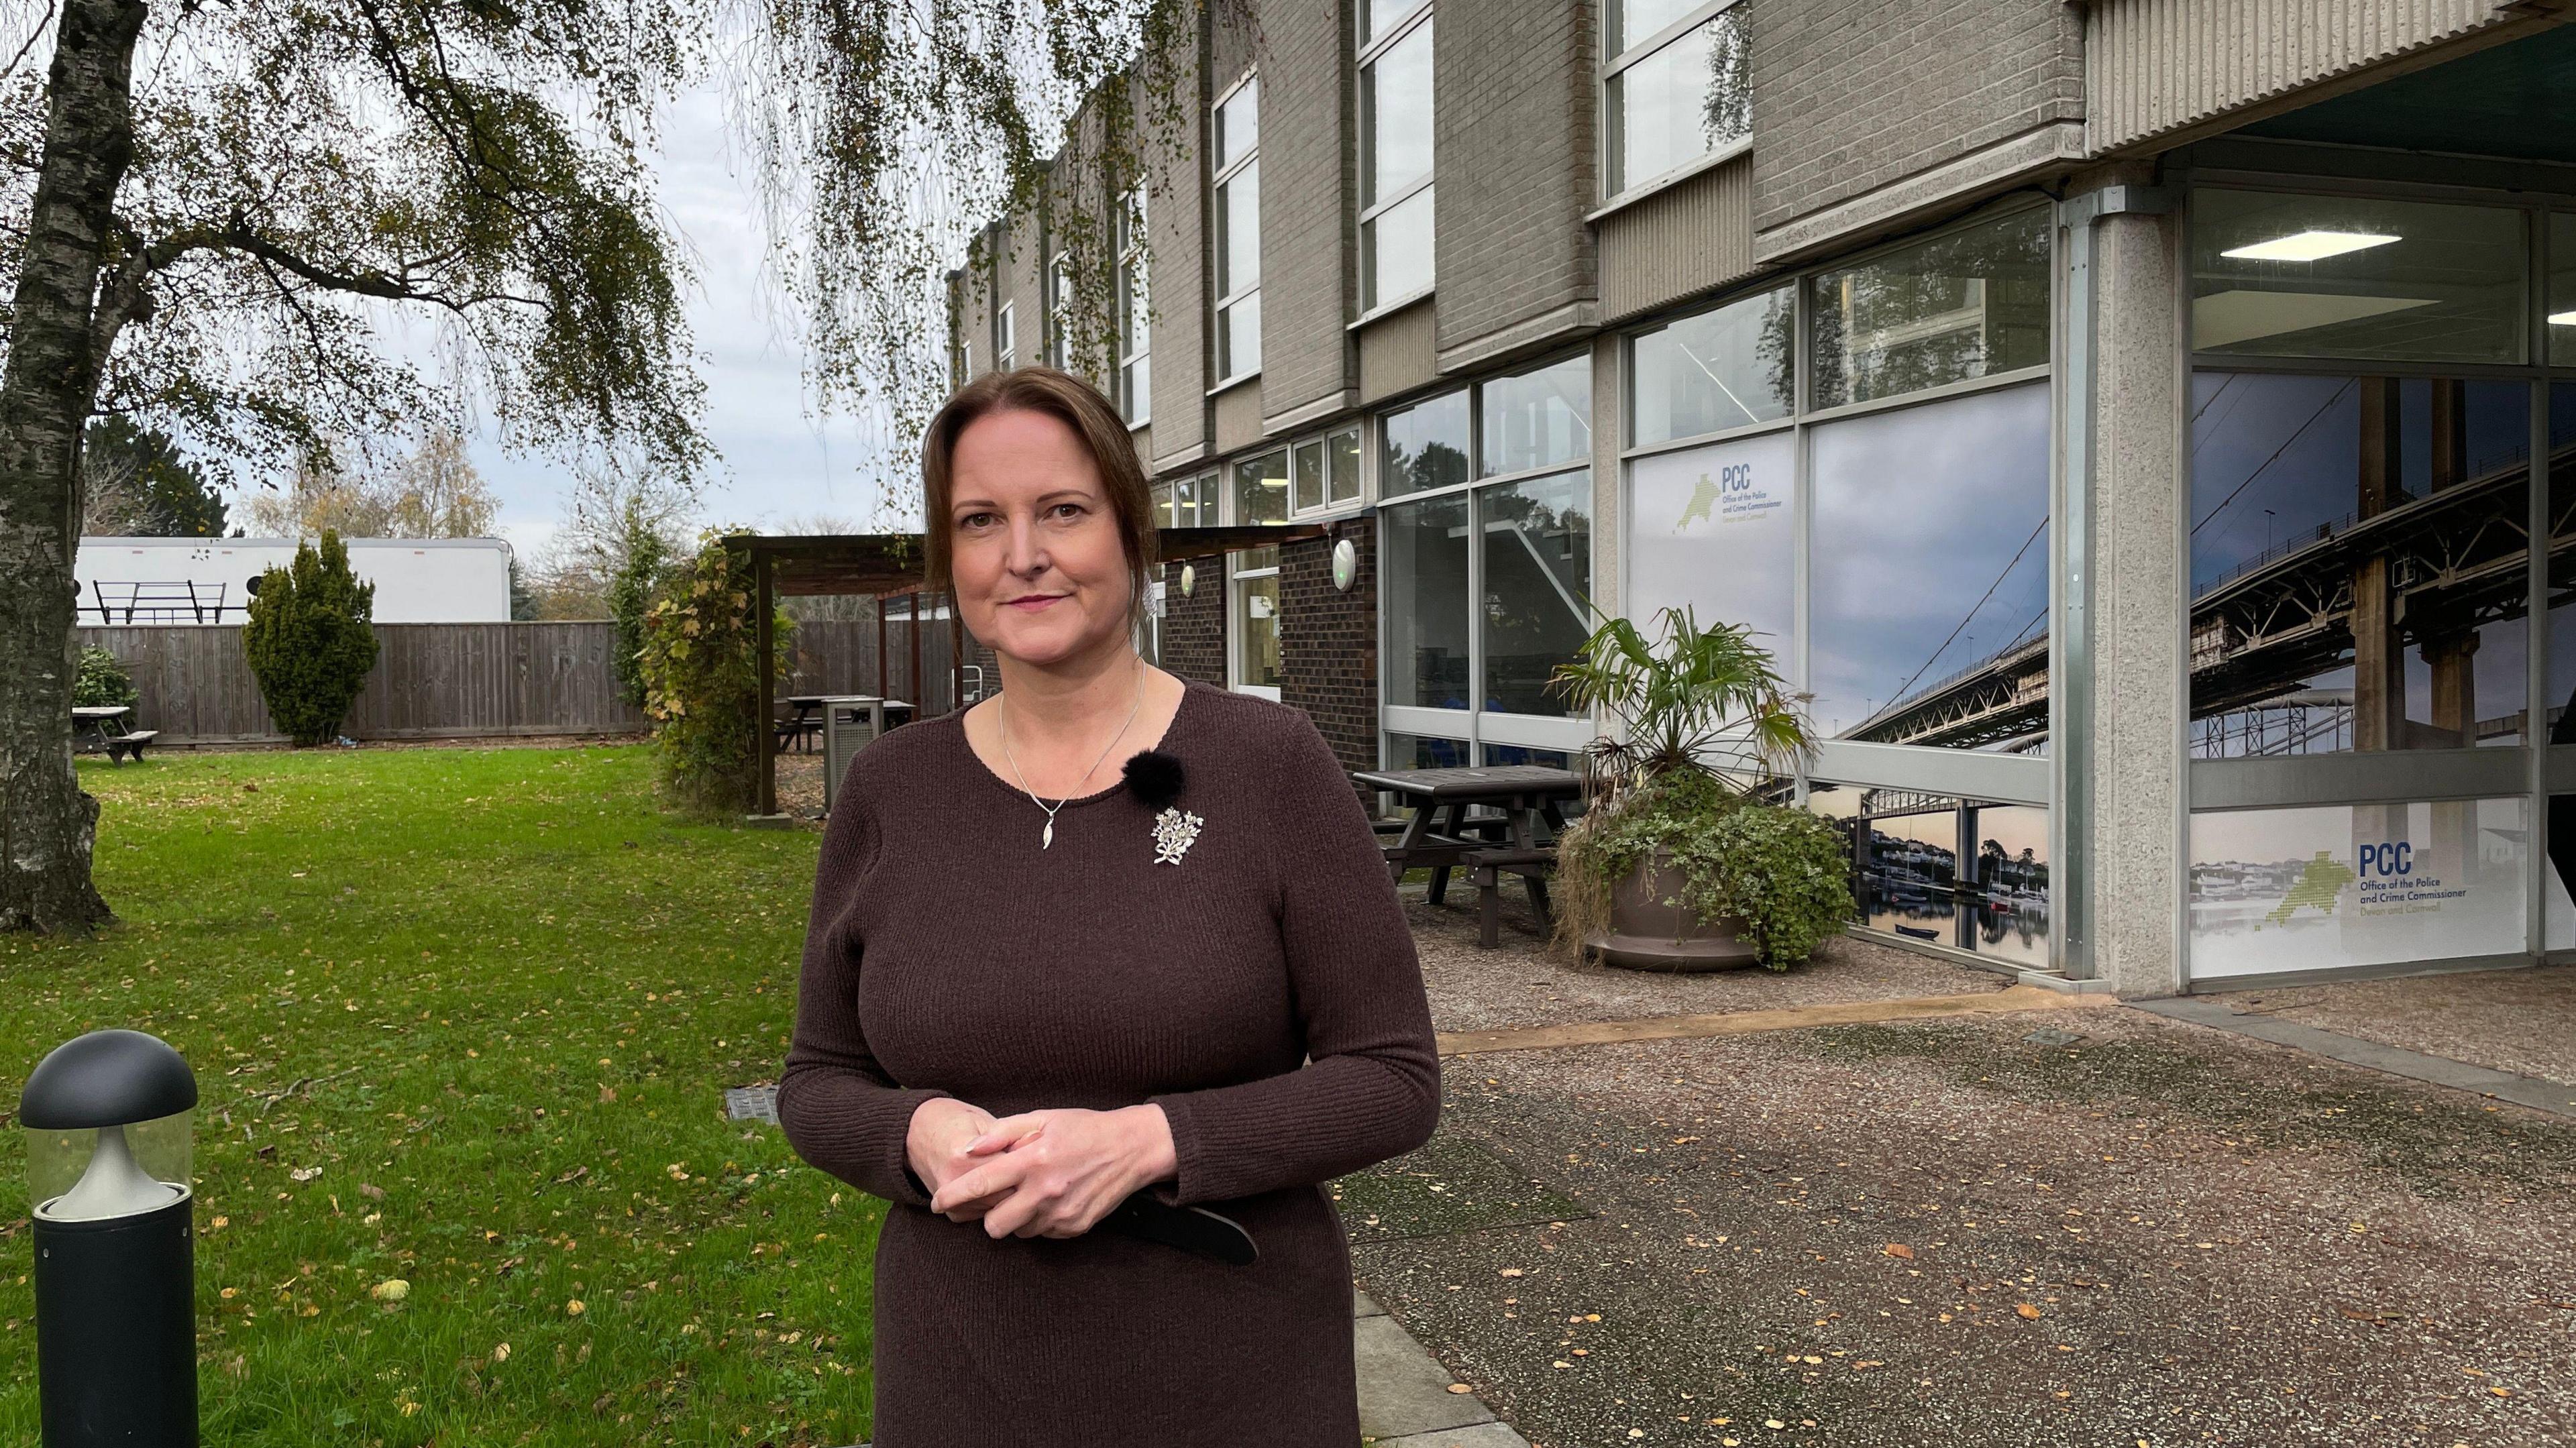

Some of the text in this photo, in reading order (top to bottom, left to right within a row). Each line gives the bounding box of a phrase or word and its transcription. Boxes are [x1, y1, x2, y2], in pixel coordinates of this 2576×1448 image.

[1723, 463, 1750, 493] PCC
[1723, 494, 1737, 504] Office
[1737, 492, 1743, 502] of
[1752, 491, 1766, 499] Police
[1723, 500, 1782, 514] and Crime Commissioner
[2360, 842, 2412, 877] PCC
[2360, 877, 2440, 891] Office of the Police
[2360, 889, 2467, 903] and Crime Commissioner
[2360, 901, 2440, 916] Devon and Cornwall
